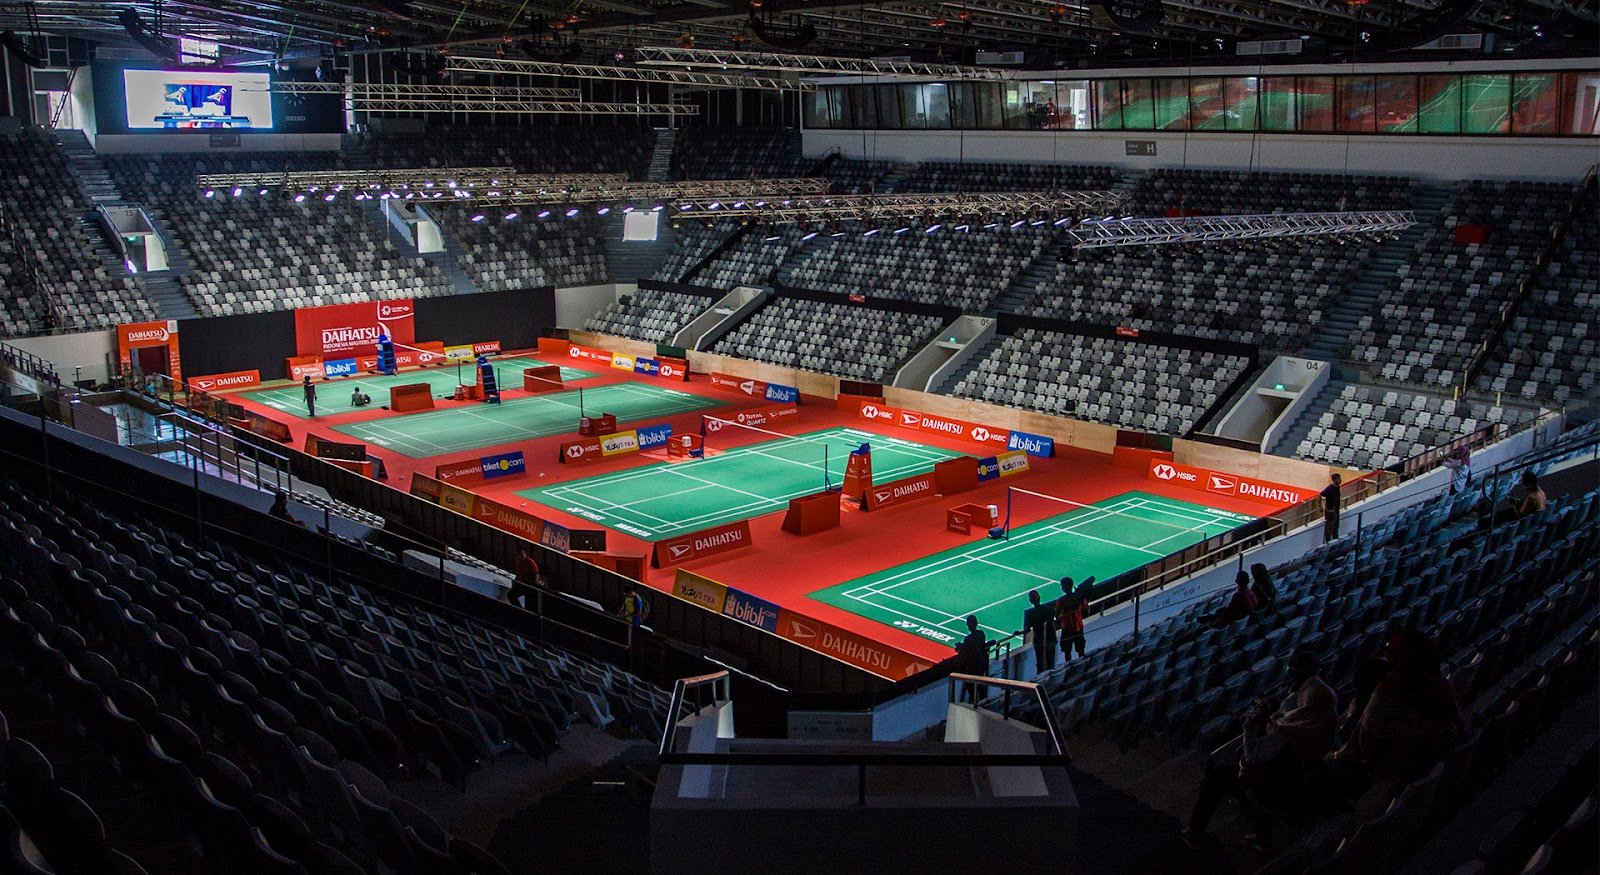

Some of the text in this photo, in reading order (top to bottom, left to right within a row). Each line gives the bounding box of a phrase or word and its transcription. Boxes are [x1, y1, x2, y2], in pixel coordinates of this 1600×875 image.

[1146, 143, 1154, 154] H
[128, 330, 163, 339] DAIHATSU
[321, 326, 380, 343] DAIHATSU
[323, 341, 348, 350] INDONESIA
[1306, 360, 1319, 371] 04
[217, 376, 254, 386] DAIHATSU
[747, 417, 767, 426] QUARTZ
[922, 417, 964, 435] DAIHATSU
[990, 433, 1007, 443] HSBC
[584, 444, 600, 453] HSBC
[455, 467, 482, 477] DAIHATSU
[1177, 471, 1197, 481] HSBC
[893, 480, 930, 498] DAIHATSU
[1240, 482, 1299, 504] DAIHATSU
[497, 511, 537, 535] DAIHATSU
[695, 530, 742, 551] DAIHATSU
[703, 594, 716, 605] TEA
[915, 626, 955, 642] YONEX
[822, 633, 891, 670] DAIHATSU
